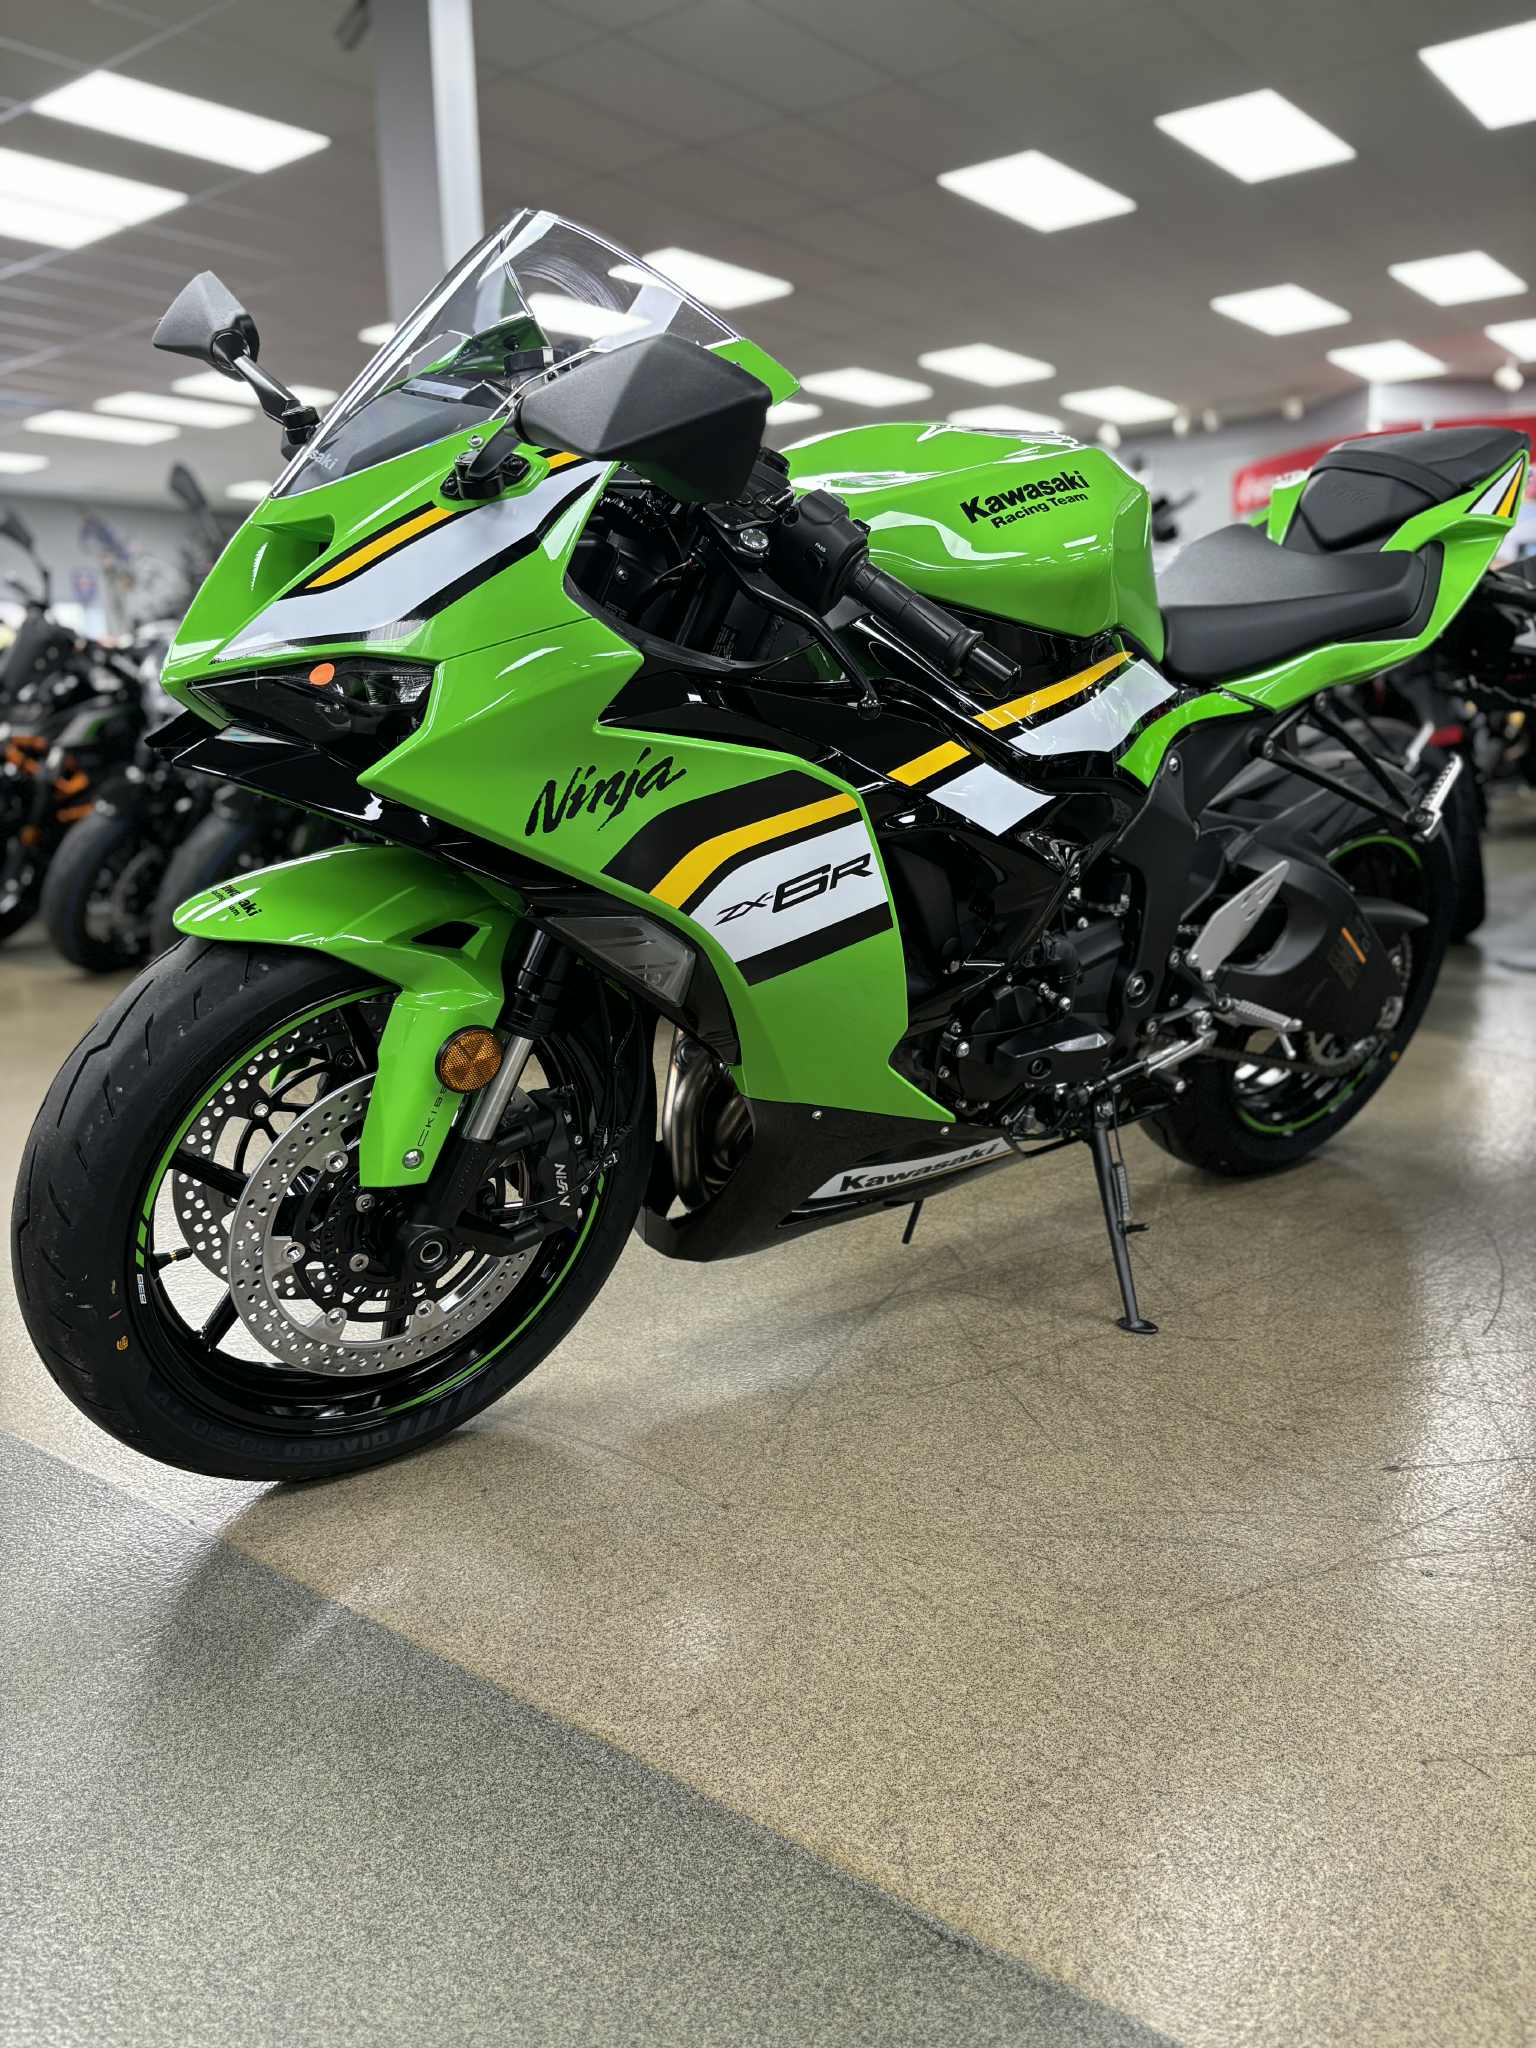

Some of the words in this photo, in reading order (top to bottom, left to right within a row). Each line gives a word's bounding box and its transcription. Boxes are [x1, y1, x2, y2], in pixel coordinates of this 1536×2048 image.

[960, 470, 1090, 523] Kawasaki
[990, 502, 1051, 528] Racing
[1046, 492, 1089, 507] Team
[525, 747, 688, 836] Ninja
[713, 853, 874, 926] ZX-6R
[839, 1143, 999, 1192] Kawasaki
